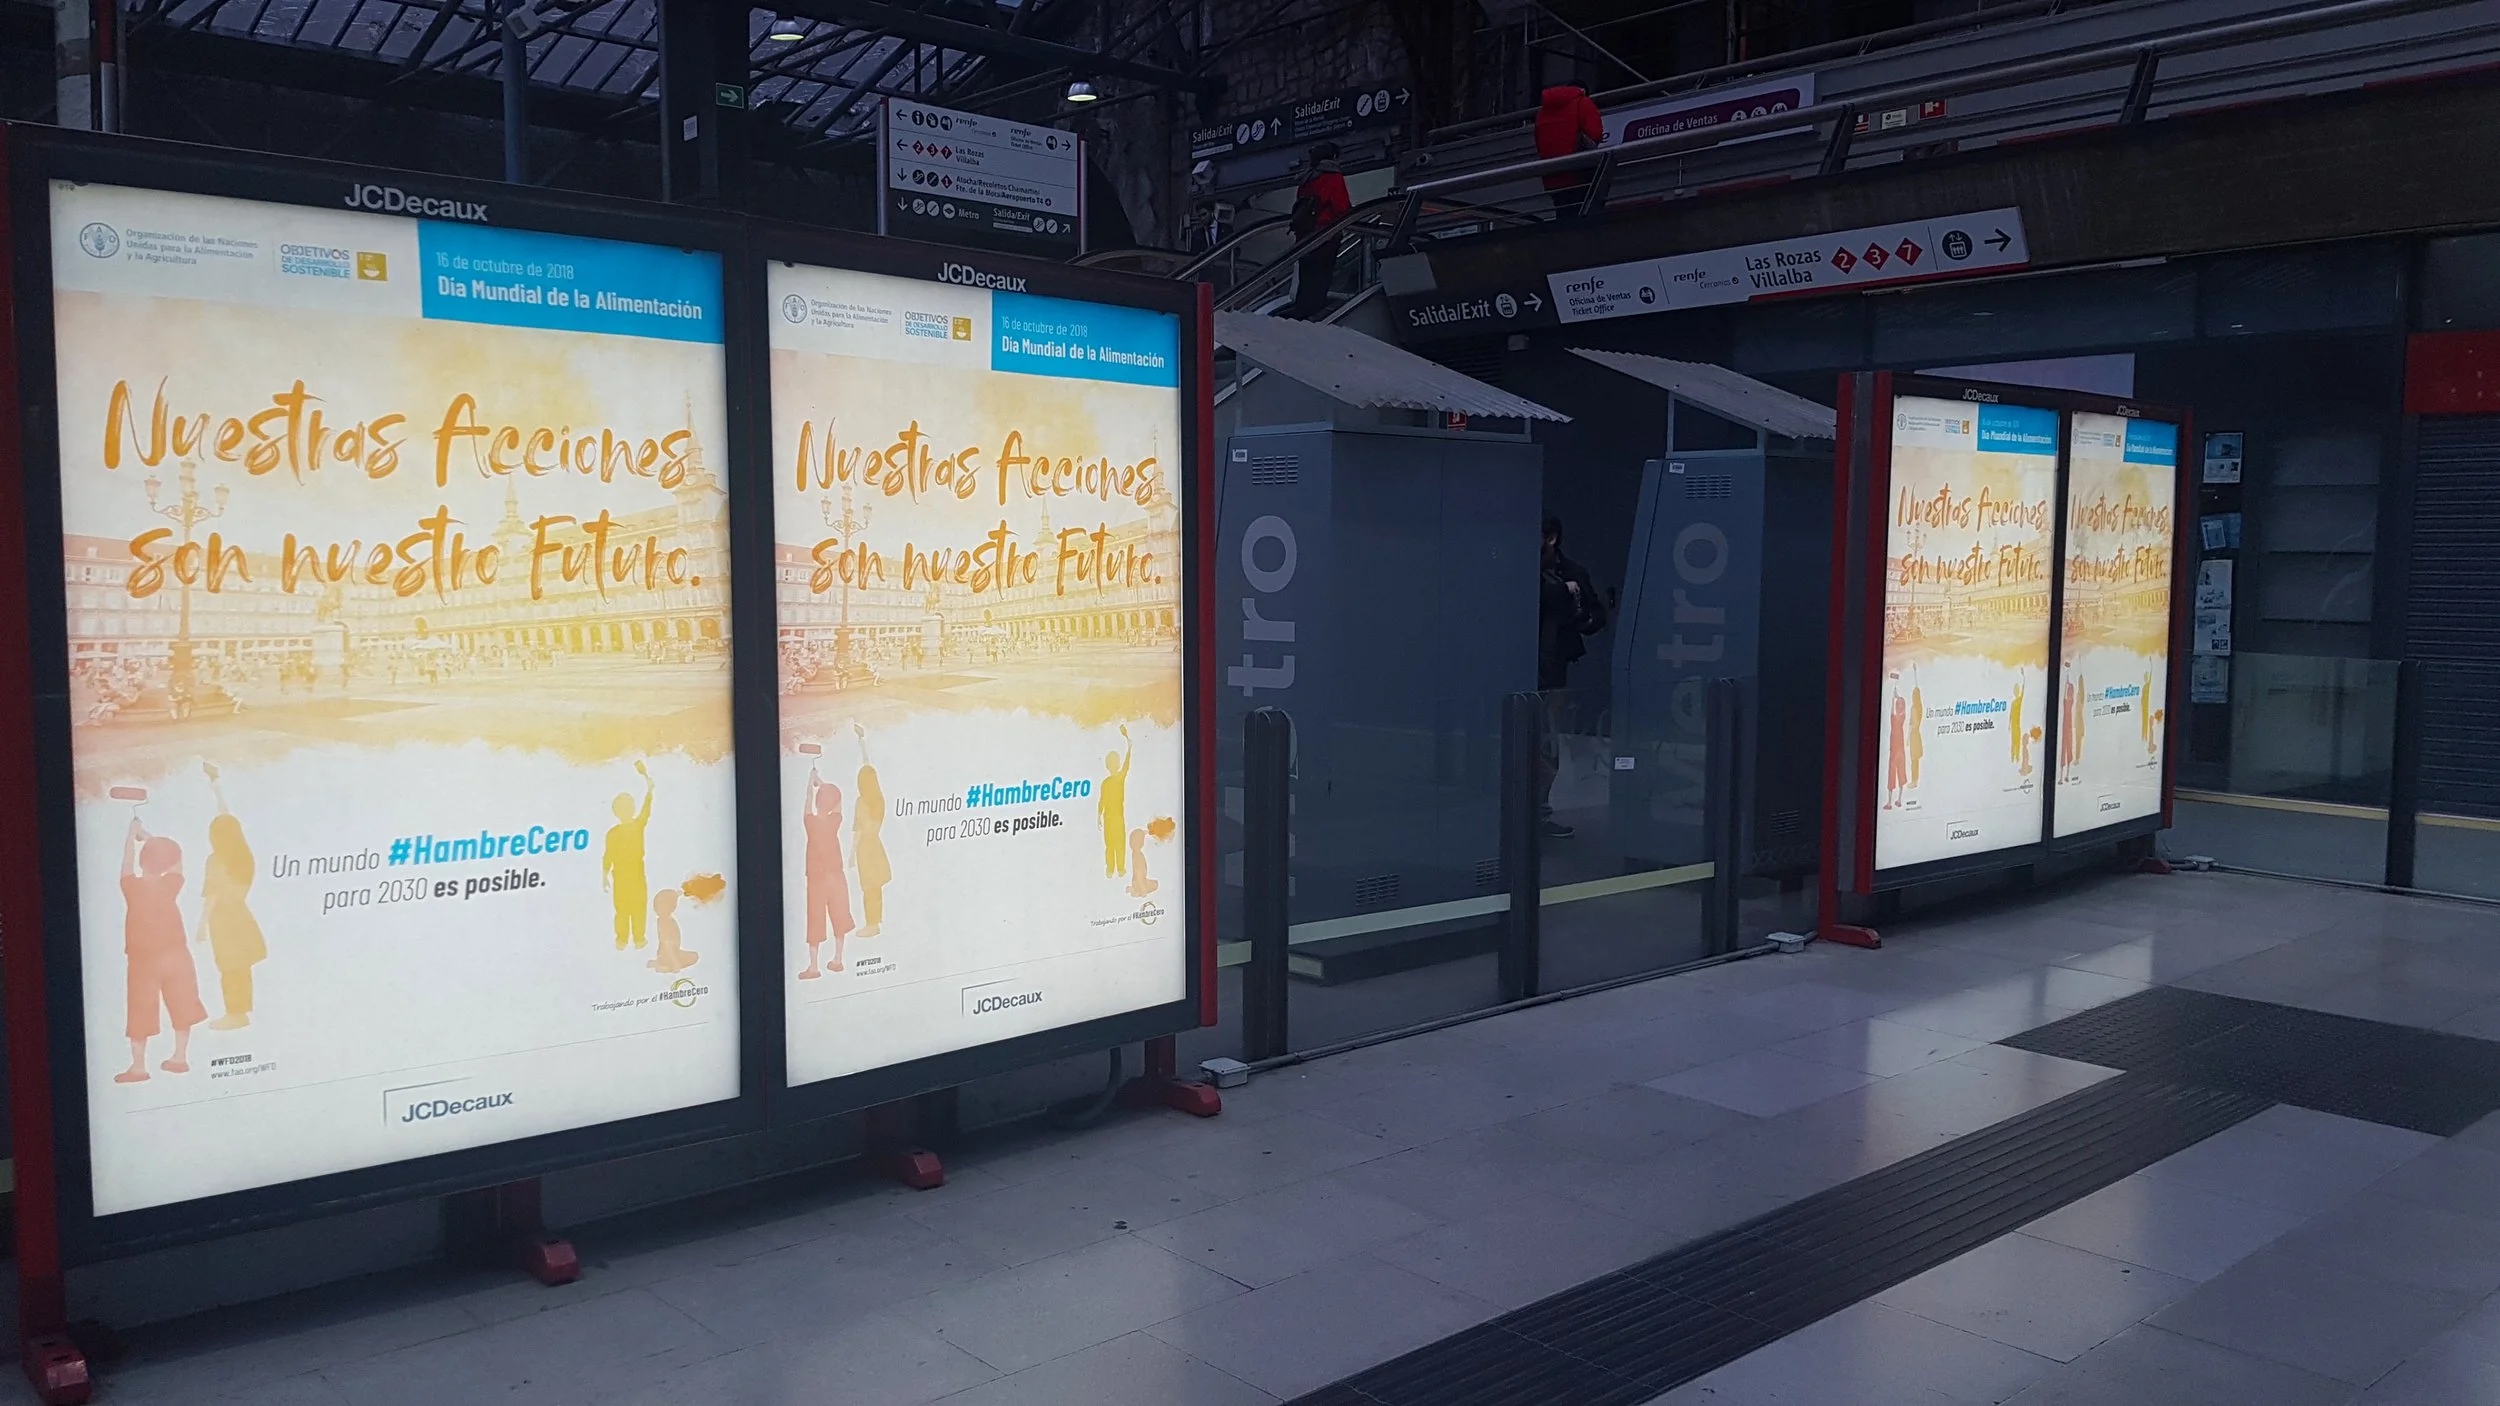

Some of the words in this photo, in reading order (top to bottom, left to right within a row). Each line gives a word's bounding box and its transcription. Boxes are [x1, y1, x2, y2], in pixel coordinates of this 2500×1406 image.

[1294, 97, 1341, 119] Salida/Exit
[955, 117, 978, 128] renfe
[1637, 124, 1670, 139] Oficina
[1673, 121, 1685, 132] de
[1686, 113, 1718, 129] Ventas
[1010, 128, 1032, 138] renfe
[1192, 123, 1233, 144] Salida/Exit
[956, 146, 965, 155] Las
[967, 148, 984, 158] Rozas
[956, 156, 980, 166] Villalba
[969, 186, 977, 194] de
[345, 183, 488, 222] JCDecaux
[958, 208, 980, 219] Metro
[993, 208, 1030, 221] Salida/Exit
[126, 240, 158, 251] Unidas
[160, 244, 181, 254] para
[184, 244, 192, 253] la
[189, 235, 200, 243] de
[202, 236, 215, 245] las
[217, 237, 258, 249] Naciones
[126, 253, 132, 261] y
[135, 252, 143, 260] la
[145, 253, 197, 265] Agricultura
[280, 244, 350, 260] OBJETIVOS
[1745, 255, 1771, 272] Las
[1775, 249, 1822, 268] Rozas
[1838, 252, 1851, 269] 2
[1870, 249, 1882, 265] 3
[1901, 243, 1913, 260] 7
[282, 264, 350, 278] SOSTENIBLE
[436, 252, 450, 268] 16
[452, 256, 469, 270] de
[473, 258, 524, 276] octubre
[527, 261, 543, 277] de
[546, 263, 575, 280] 2018
[1673, 268, 1706, 282] renfe
[937, 262, 1027, 293] JCDecaux
[1565, 275, 1605, 294] renfe
[1749, 268, 1813, 290] Villalba
[437, 275, 468, 297] Día
[472, 280, 543, 305] Mundial
[547, 286, 569, 307] de
[574, 288, 590, 309] la
[595, 291, 703, 320] Alimentación
[1569, 295, 1596, 306] Oficina
[1597, 293, 1606, 304] de
[1606, 291, 1631, 303] Ventas
[811, 299, 848, 310] Organización
[857, 304, 866, 312] las
[866, 306, 893, 316] Naciones
[811, 309, 831, 317] Unidas
[831, 312, 845, 320] para
[846, 312, 852, 320] la
[852, 313, 889, 324] Alimentación
[1409, 299, 1491, 327] Salida/Exit
[1572, 305, 1593, 316] Ticket
[1594, 303, 1615, 316] Office
[823, 319, 854, 329] Agricultura
[904, 311, 949, 324] OBJETIVOS
[1001, 316, 1010, 328] 16
[1011, 318, 1022, 331] de
[1023, 321, 1054, 335] octubre
[1056, 323, 1067, 336] de
[1070, 324, 1088, 338] 2018
[905, 327, 949, 339] SOSTENIBLE
[1002, 335, 1020, 353] Día
[1022, 338, 1066, 358] Mundial
[1069, 343, 1084, 360] de
[1087, 345, 1096, 361] la
[1099, 346, 1164, 369] Alimentación
[1963, 388, 1998, 403] JCDecaux
[104, 375, 407, 486] Nuestras
[433, 392, 695, 490] Acciones
[796, 416, 981, 505] Nuestras
[997, 429, 1158, 506] Acciones
[1898, 483, 1972, 531] Nuestras
[1977, 486, 2047, 532] Acciones
[127, 527, 253, 599] son
[281, 504, 500, 606] nuestro
[528, 509, 702, 606] Futuro.
[810, 537, 886, 594] son
[903, 519, 1039, 600] nuestro
[1056, 521, 1162, 600] Futuro.
[1900, 553, 1930, 586] son
[1936, 541, 1991, 588] nuestro
[1935, 706, 1953, 717] mundo
[1954, 698, 2007, 715] #HambreCero
[1937, 724, 1950, 736] para
[1951, 721, 1964, 733] 2030
[1965, 723, 1972, 731] es
[895, 798, 913, 816] Un
[917, 793, 962, 815] mundo
[966, 776, 1091, 809] #HambreCero
[926, 824, 956, 847] para
[960, 817, 990, 839] 2030
[994, 819, 1009, 834] es
[1012, 810, 1063, 836] posible.
[1950, 829, 1979, 840] JCDecaux
[272, 854, 300, 878] Un
[307, 848, 380, 875] mundo
[387, 825, 590, 867] #HambreCero
[322, 887, 371, 915] para
[378, 877, 428, 903] 2030
[434, 878, 458, 898] es
[464, 868, 546, 900] posible.
[591, 998, 634, 1011] Trabajando
[636, 997, 650, 1007] por
[651, 995, 659, 1003] el
[659, 986, 709, 1001] #HambreCero
[973, 991, 1043, 1015] JCDecaux
[211, 1054, 252, 1067] #WFD2018
[401, 1092, 514, 1122] JCDecaux
